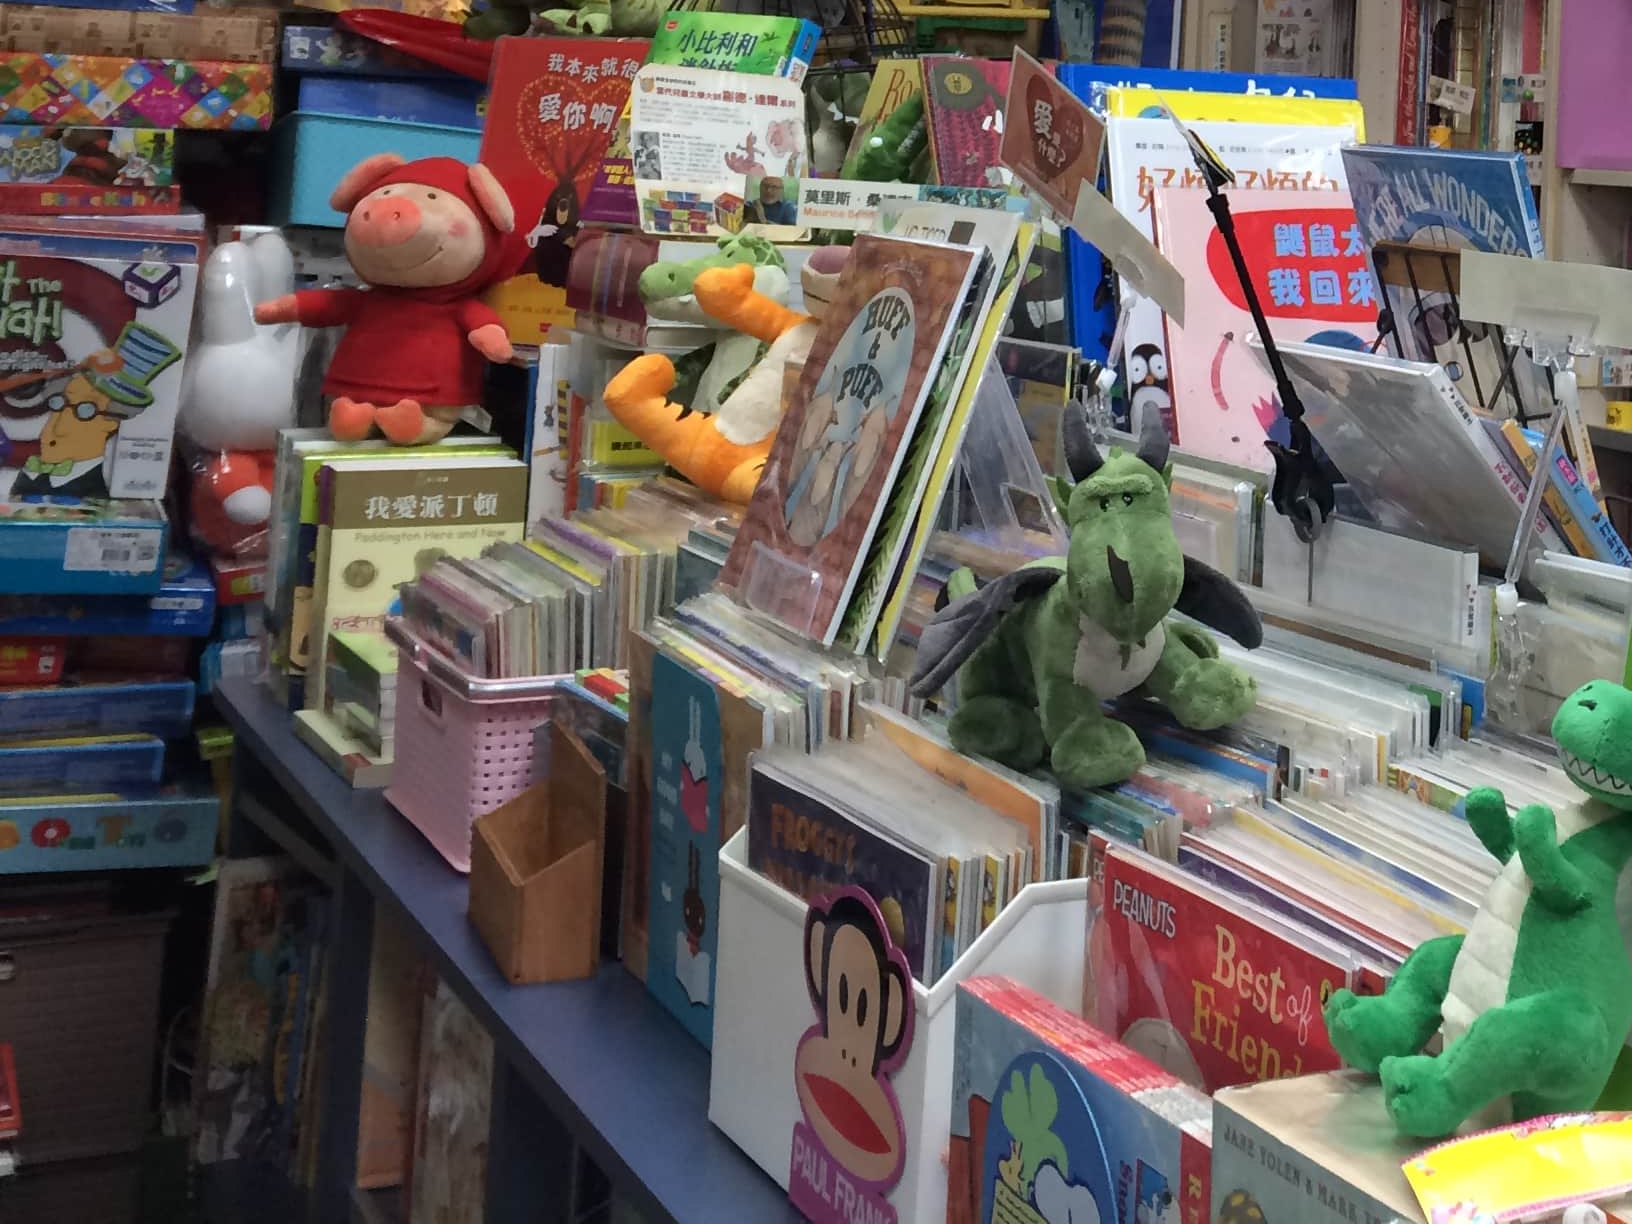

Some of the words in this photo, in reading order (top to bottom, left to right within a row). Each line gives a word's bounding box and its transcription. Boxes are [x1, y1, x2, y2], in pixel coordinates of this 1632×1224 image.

[678, 29, 759, 57] 小比利和
[547, 52, 641, 84] 我本來就很
[537, 92, 618, 134] 愛你啊
[804, 188, 913, 207] 莫里斯・桑
[1393, 169, 1431, 218] ALL
[1266, 266, 1377, 308] 我回來
[861, 295, 911, 341] HUFF
[836, 362, 884, 410] PUFF
[364, 492, 499, 520] 我愛派丁頓
[355, 530, 421, 544] Paddington
[424, 529, 453, 540] Here
[456, 528, 477, 539] and
[1113, 878, 1178, 939] PEANUTS
[1211, 923, 1284, 1025] Best
[1286, 984, 1313, 1047] of
[793, 1134, 831, 1204] PAUL
[1223, 1126, 1255, 1159] JANE
[1259, 1145, 1301, 1189] YOLEN
[1317, 1182, 1357, 1223] MARK
